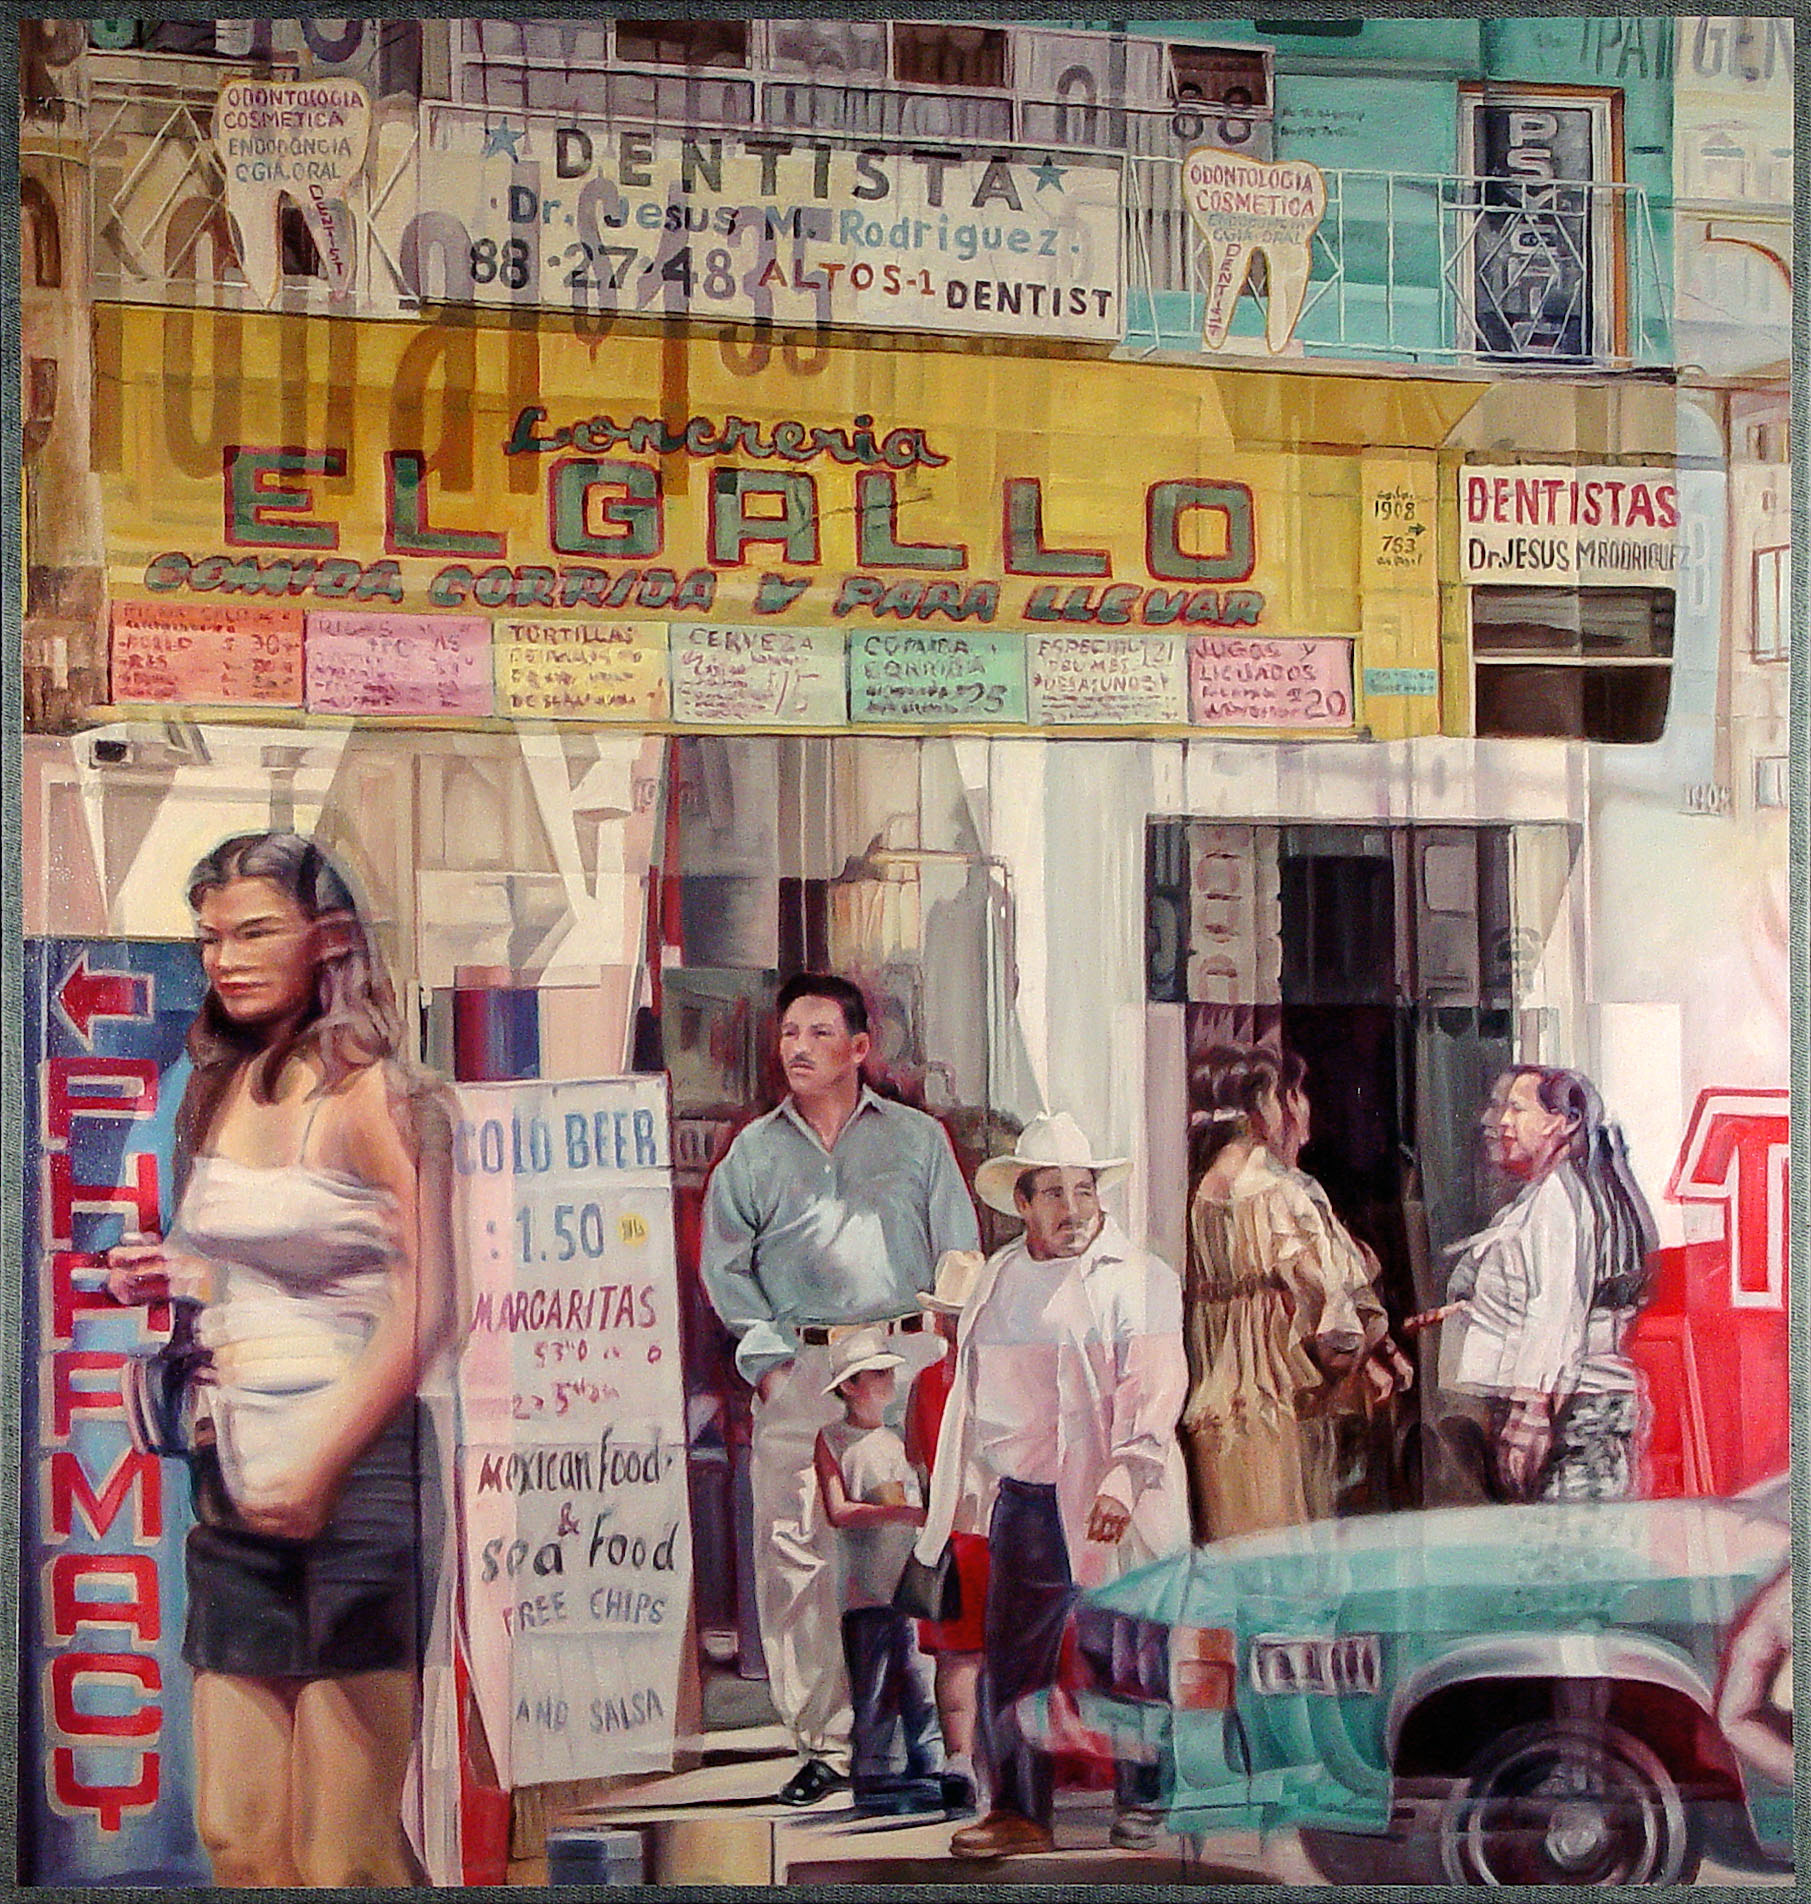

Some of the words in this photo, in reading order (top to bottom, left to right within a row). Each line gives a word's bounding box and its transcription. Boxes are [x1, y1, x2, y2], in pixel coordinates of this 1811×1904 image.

[227, 87, 364, 109] ODONTOLOGIA
[223, 110, 344, 129] COSMETICA
[555, 128, 1023, 212] DENTISTA
[1190, 164, 1314, 194] ODONTOLOGIA
[508, 184, 575, 227] Dr.
[603, 193, 739, 234] Jesus
[764, 205, 817, 244] M.
[1195, 188, 1315, 217] COSMETICA
[758, 259, 936, 297] ALTOS-1
[945, 279, 1113, 320] DENTIST
[224, 444, 508, 560] EL
[547, 457, 1258, 584] GALLO
[1467, 476, 1681, 529] DENTISTAS
[144, 551, 404, 604] COMIDA
[430, 564, 718, 613] CORRIDA
[831, 575, 1000, 623] PARA
[1021, 583, 1266, 628] LLEVAR
[688, 628, 813, 653] CERVEZA
[453, 1107, 550, 1175] COLD
[565, 1108, 656, 1170] BEER
[470, 1284, 656, 1333] MARGARITAS
[557, 1502, 581, 1537] &
[590, 1586, 665, 1624] CHIPS
[515, 1695, 568, 1732] AND
[590, 1687, 664, 1732] SALSA
